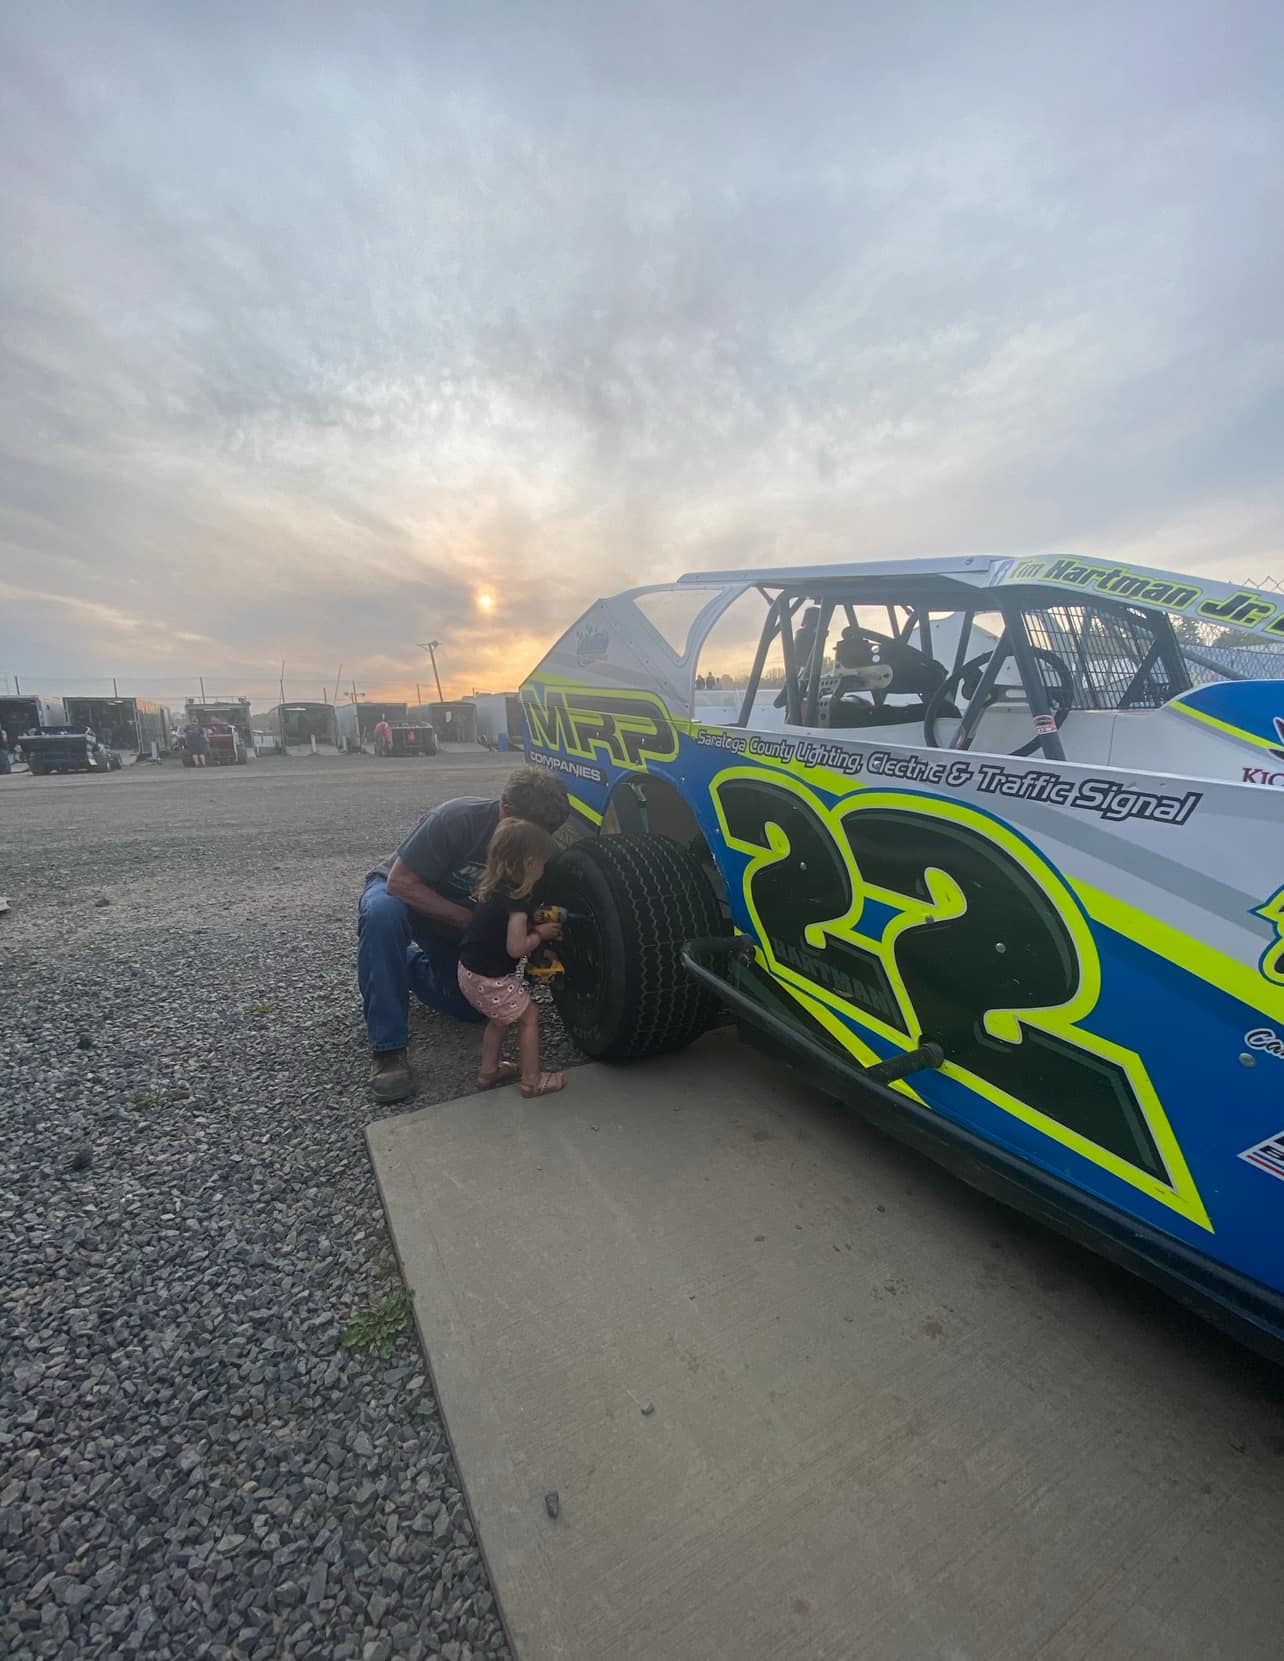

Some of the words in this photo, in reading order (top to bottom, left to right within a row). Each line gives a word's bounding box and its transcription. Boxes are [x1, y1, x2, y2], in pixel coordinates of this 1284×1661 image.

[1008, 559, 1046, 580] Tim
[1044, 557, 1202, 609] Hartman
[1198, 592, 1276, 627] Jr.
[520, 686, 679, 773] MRP
[530, 751, 601, 782] COMPANIES
[697, 730, 747, 752] Saratoga
[749, 736, 796, 762] County
[866, 750, 946, 784] Electric
[946, 761, 973, 787] &
[977, 764, 1076, 805] Traffic
[1070, 778, 1203, 826] Signal
[710, 768, 1214, 1234] 22
